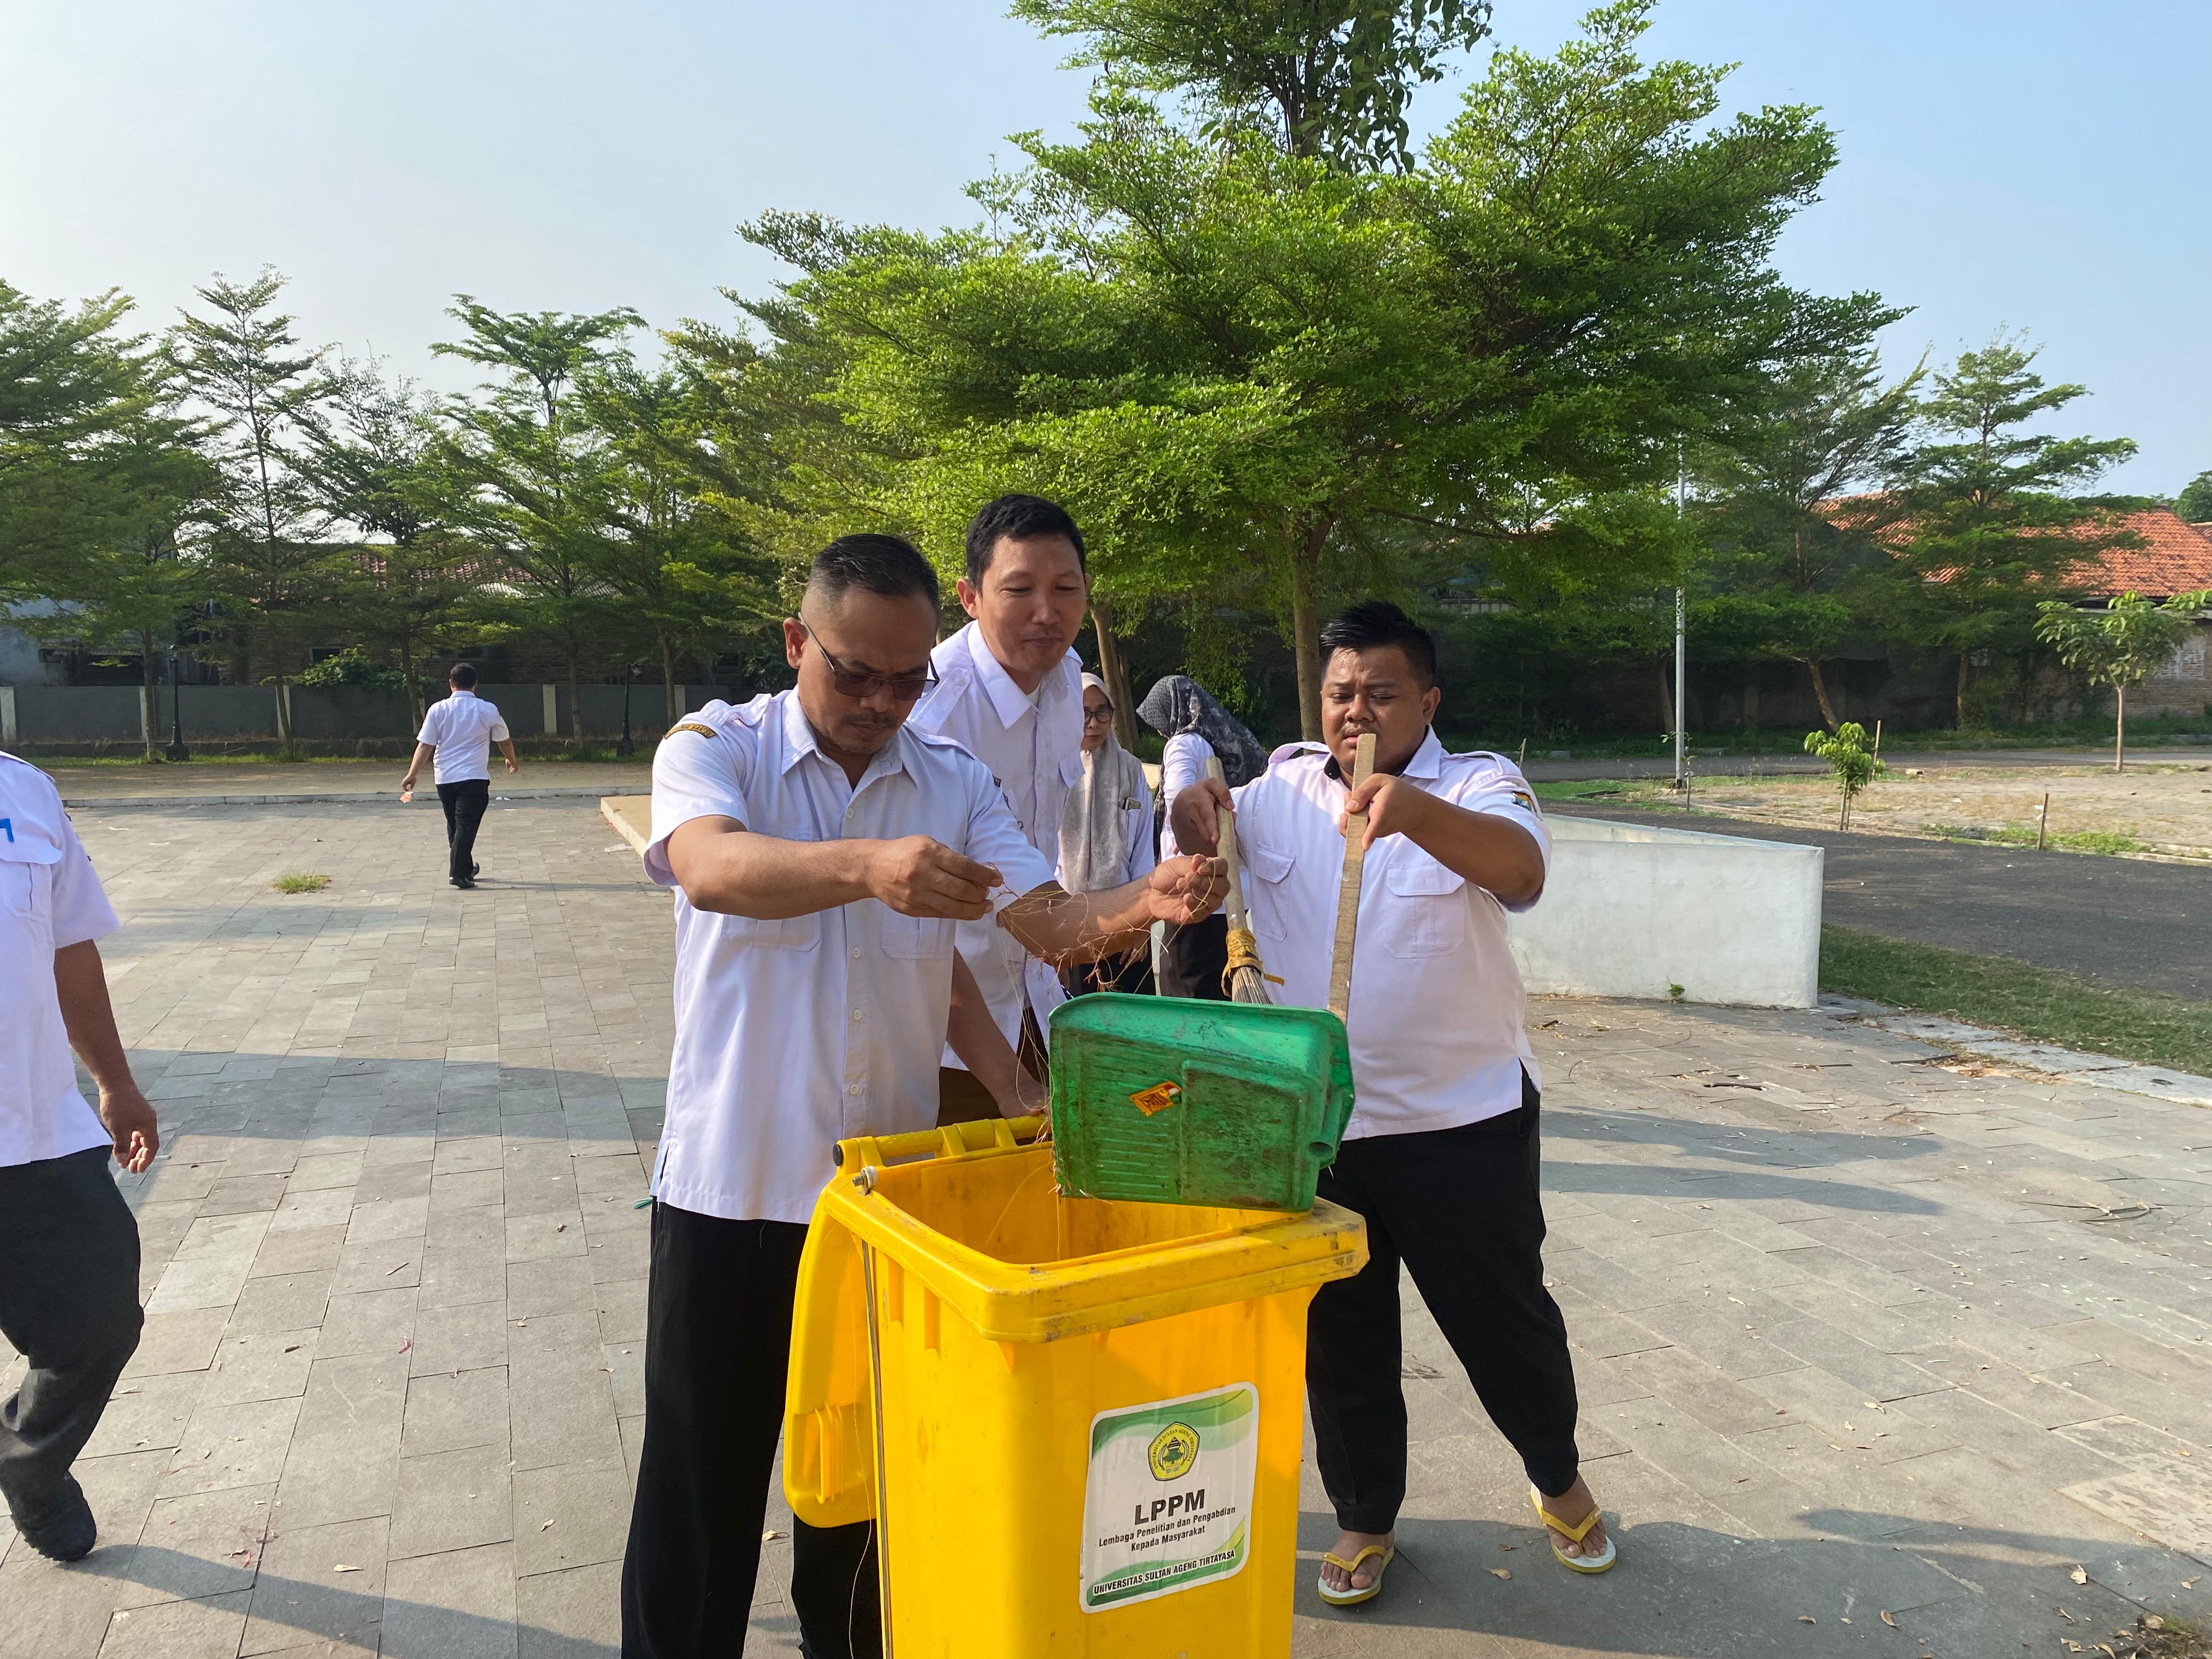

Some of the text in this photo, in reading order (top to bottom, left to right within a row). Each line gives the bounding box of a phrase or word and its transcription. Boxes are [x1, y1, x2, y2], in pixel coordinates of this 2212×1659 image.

[1135, 1488, 1205, 1525] LPPM
[1099, 1506, 1236, 1547] Lembaga Penelitian dan Pengabdian
[1131, 1525, 1206, 1551] Kepada Masyarakat
[1094, 1549, 1235, 1594] UNIVERSITAS SULTAN AGENG TIRTAYASA
